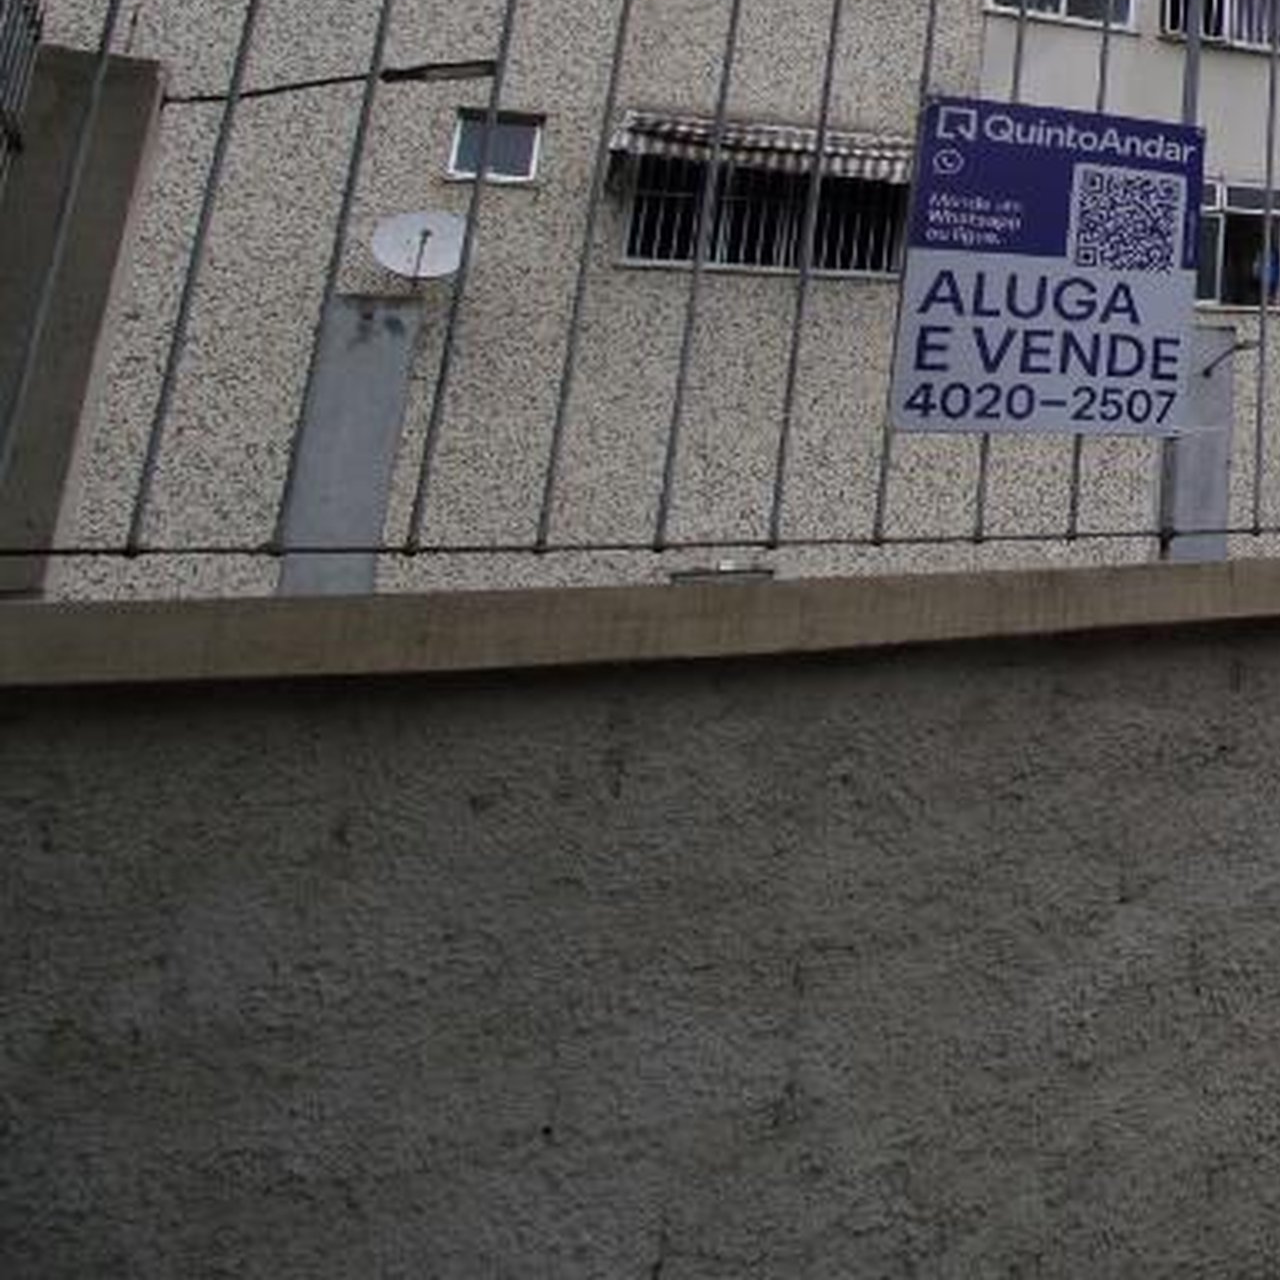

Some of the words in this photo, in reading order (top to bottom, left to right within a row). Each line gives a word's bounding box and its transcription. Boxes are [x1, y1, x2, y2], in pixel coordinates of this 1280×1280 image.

[984, 113, 1196, 163] QuintoAndar
[917, 269, 1142, 325] ALUGA
[914, 325, 953, 372] E
[972, 327, 1181, 382] VENDE
[904, 382, 1178, 425] 4020-2507
